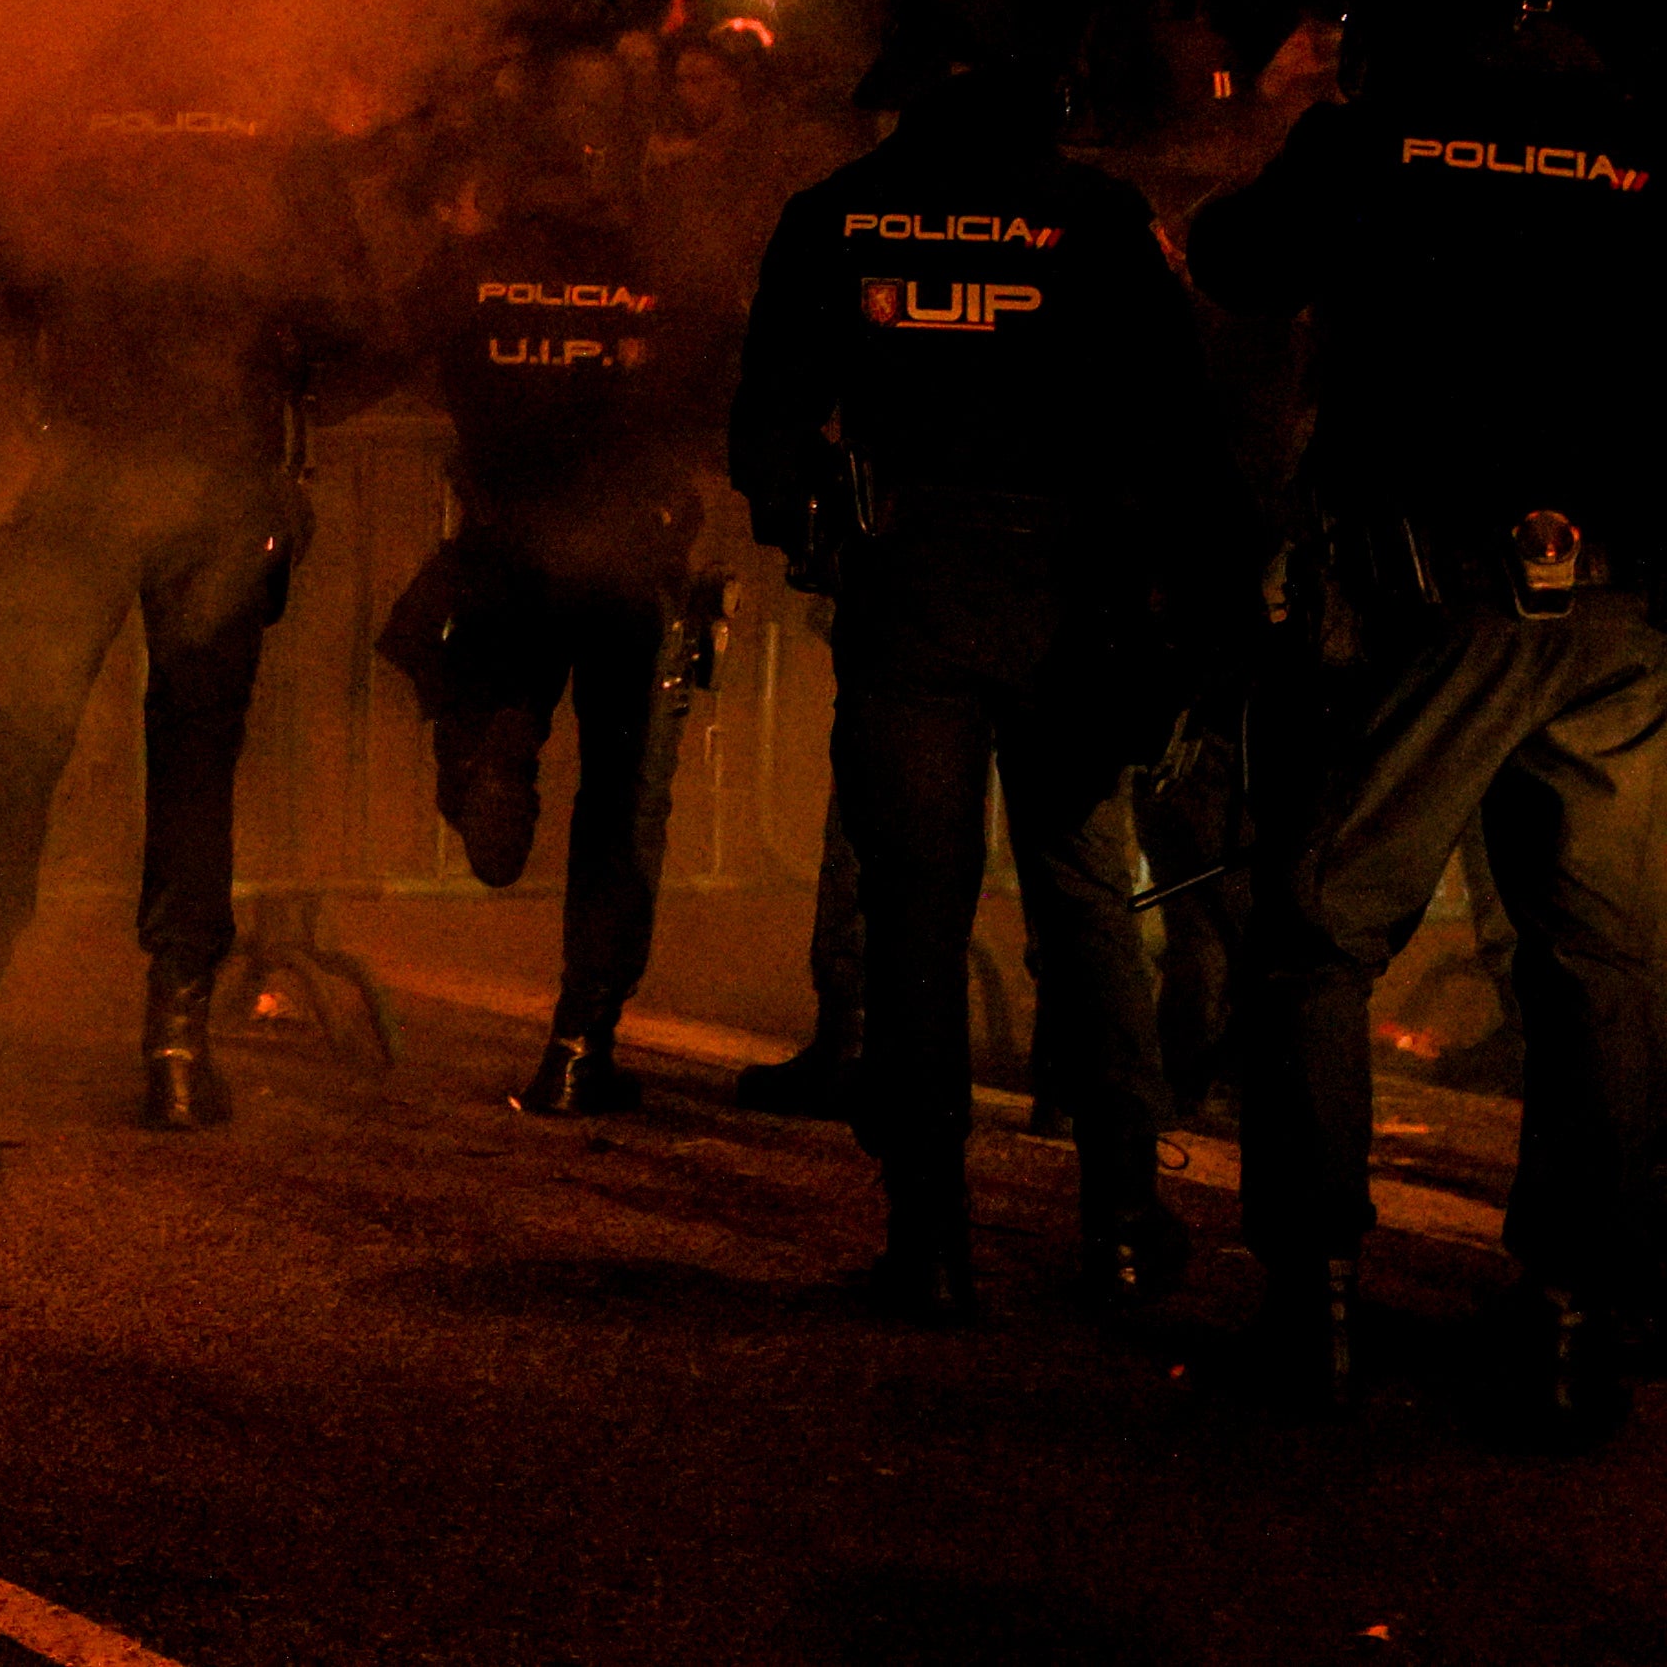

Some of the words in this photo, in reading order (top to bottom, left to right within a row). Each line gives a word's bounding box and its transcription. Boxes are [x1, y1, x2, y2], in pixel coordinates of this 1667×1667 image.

[1402, 137, 1619, 185] POLICIA
[843, 213, 1033, 243] POLICIA
[478, 282, 634, 311] POLICIA
[905, 280, 1044, 324] UIP
[489, 337, 613, 367] U.I.P.
